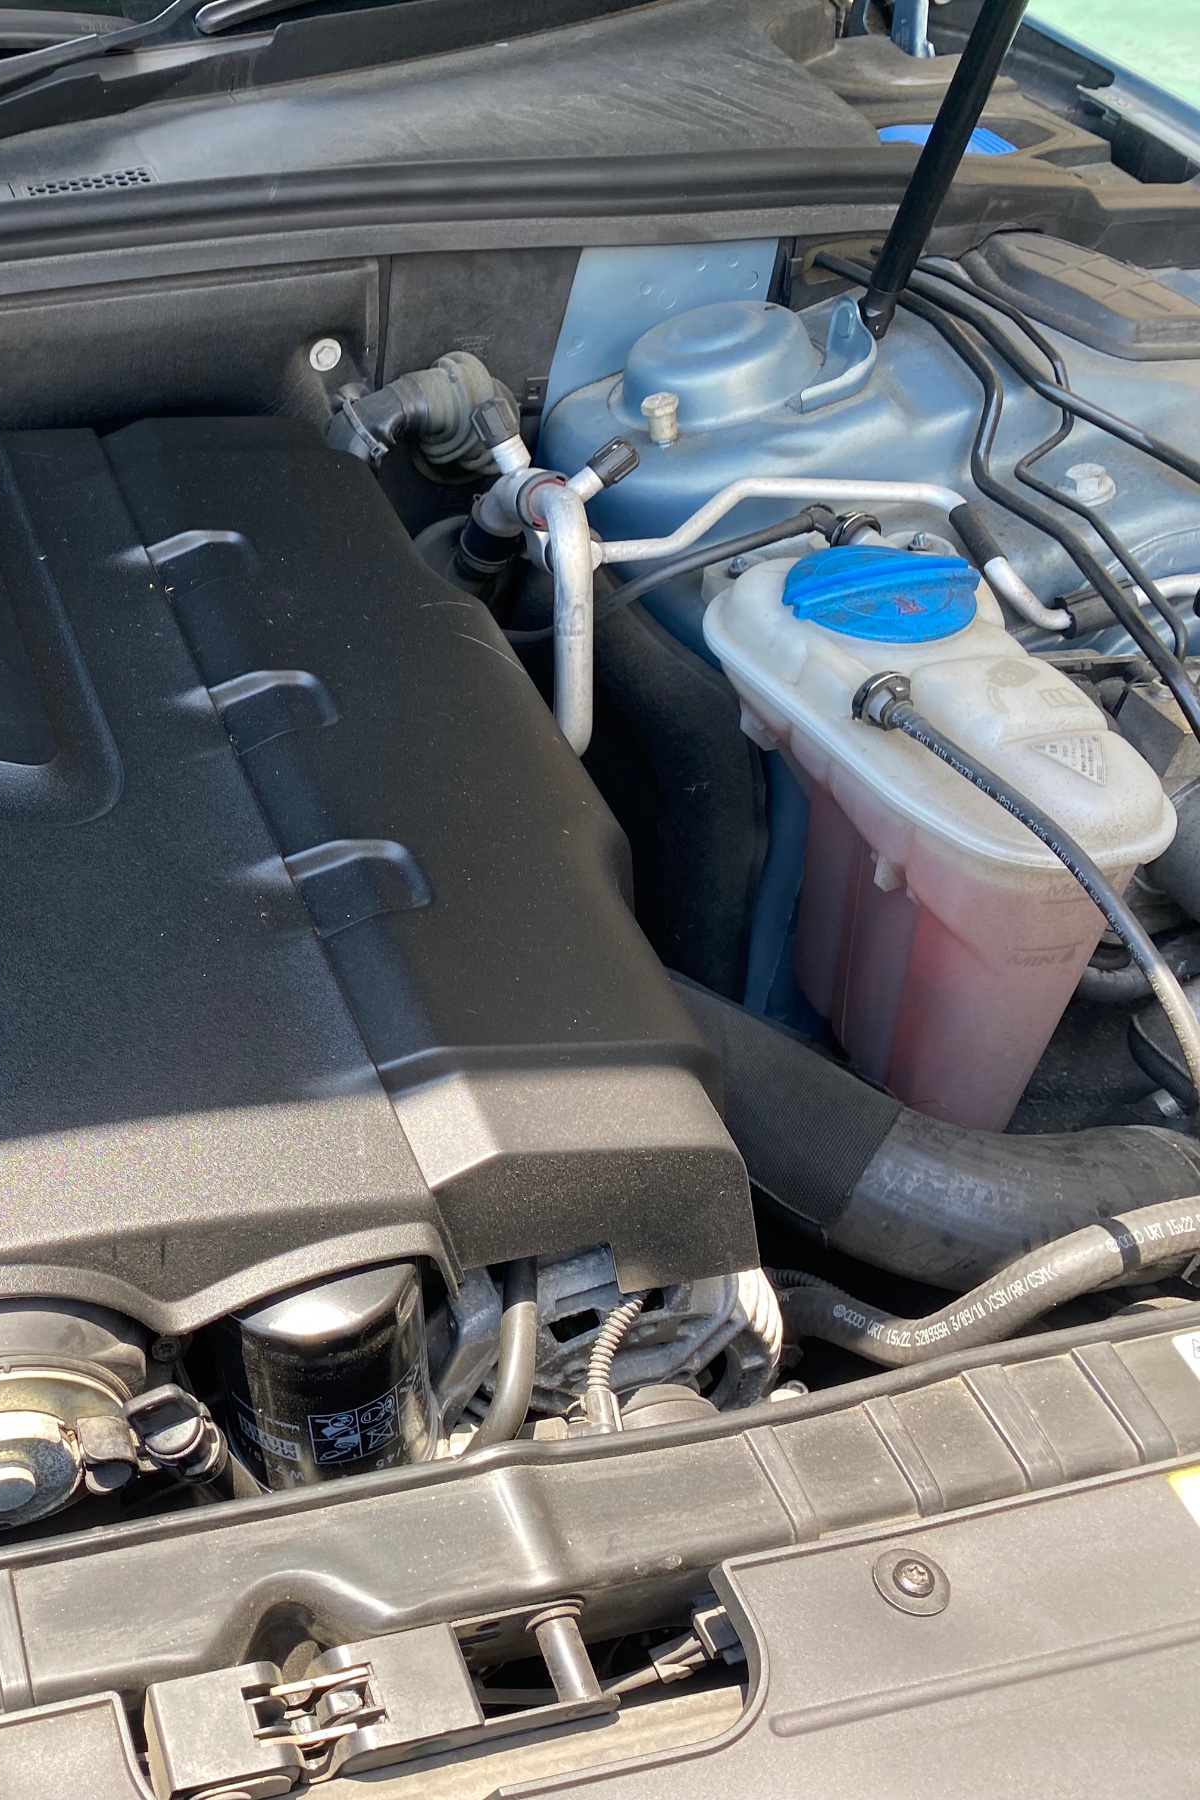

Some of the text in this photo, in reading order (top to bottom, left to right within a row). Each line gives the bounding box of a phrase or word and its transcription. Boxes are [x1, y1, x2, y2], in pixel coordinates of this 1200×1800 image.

[932, 744, 948, 760] DIN
[1165, 1215, 1197, 1236] 15x22
[885, 1328, 912, 1348] 15x22
[949, 1301, 987, 1332] 3/09/10
